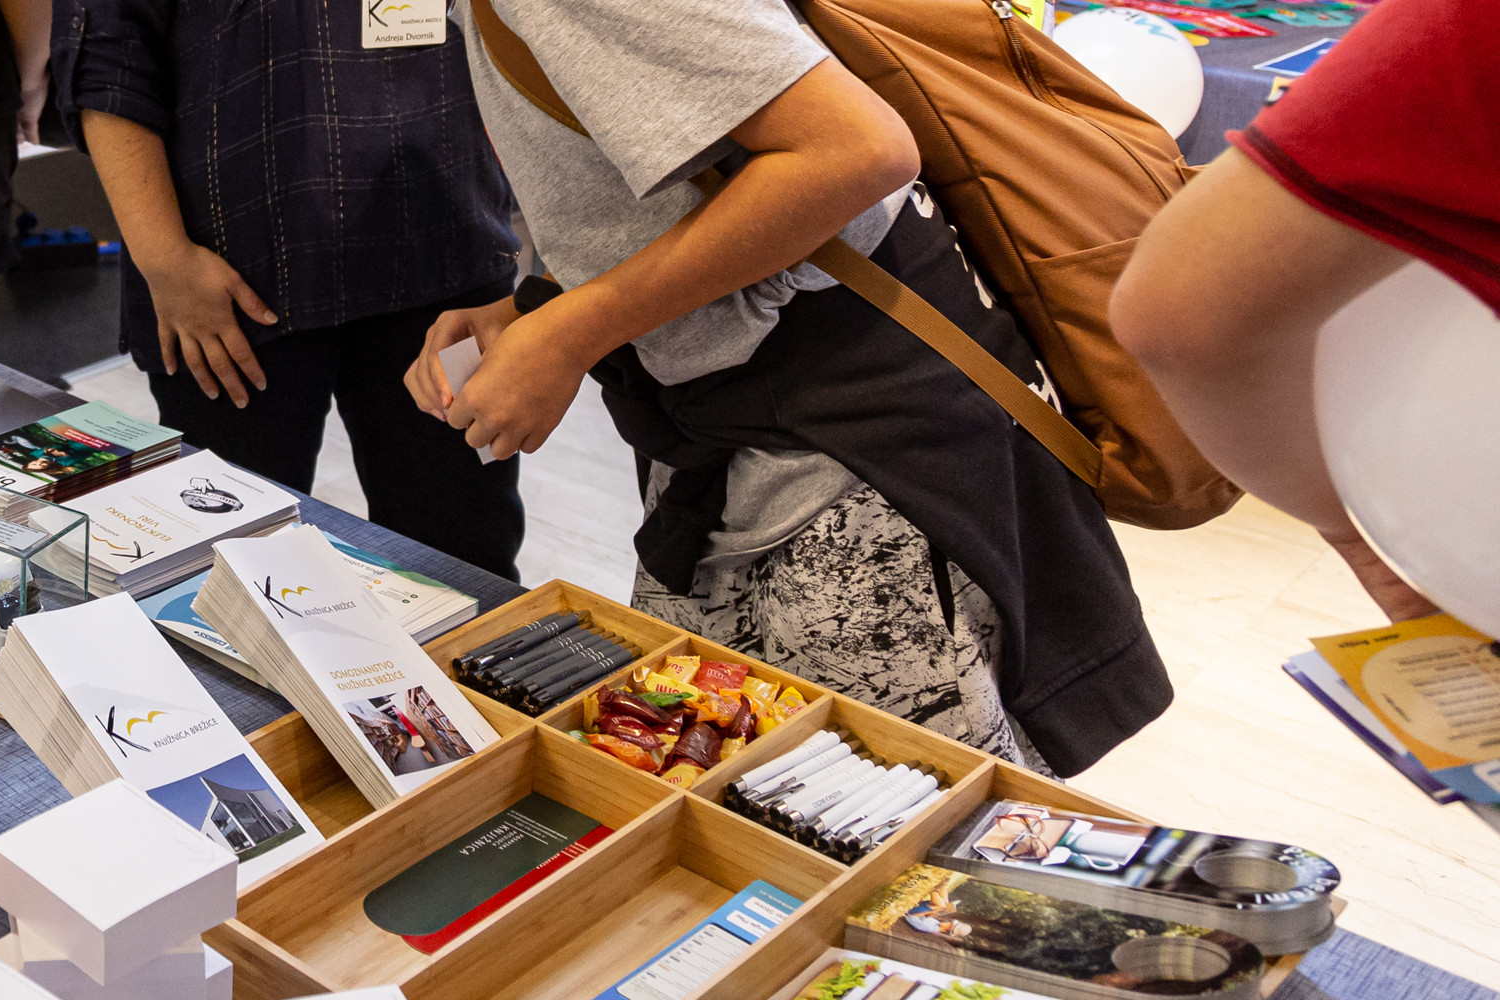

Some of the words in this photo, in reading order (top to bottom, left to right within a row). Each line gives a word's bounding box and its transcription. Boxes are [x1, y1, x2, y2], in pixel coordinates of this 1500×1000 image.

[375, 34, 404, 43] Andreja
[406, 32, 435, 41] Dvornik
[101, 505, 173, 542] ELEKTRONSKI
[134, 514, 163, 528] VIRI
[304, 605, 333, 616] KNJIŽNICA
[332, 600, 356, 612] BREŽICE
[329, 660, 394, 680] DOMOZNANSTVO
[337, 676, 375, 692] KNJIŽNICE
[373, 670, 405, 686] BREŽICE
[153, 730, 190, 748] KNJIŽNICA
[189, 718, 219, 735] BREŽICE
[459, 824, 510, 856] KNJIŽNICA
